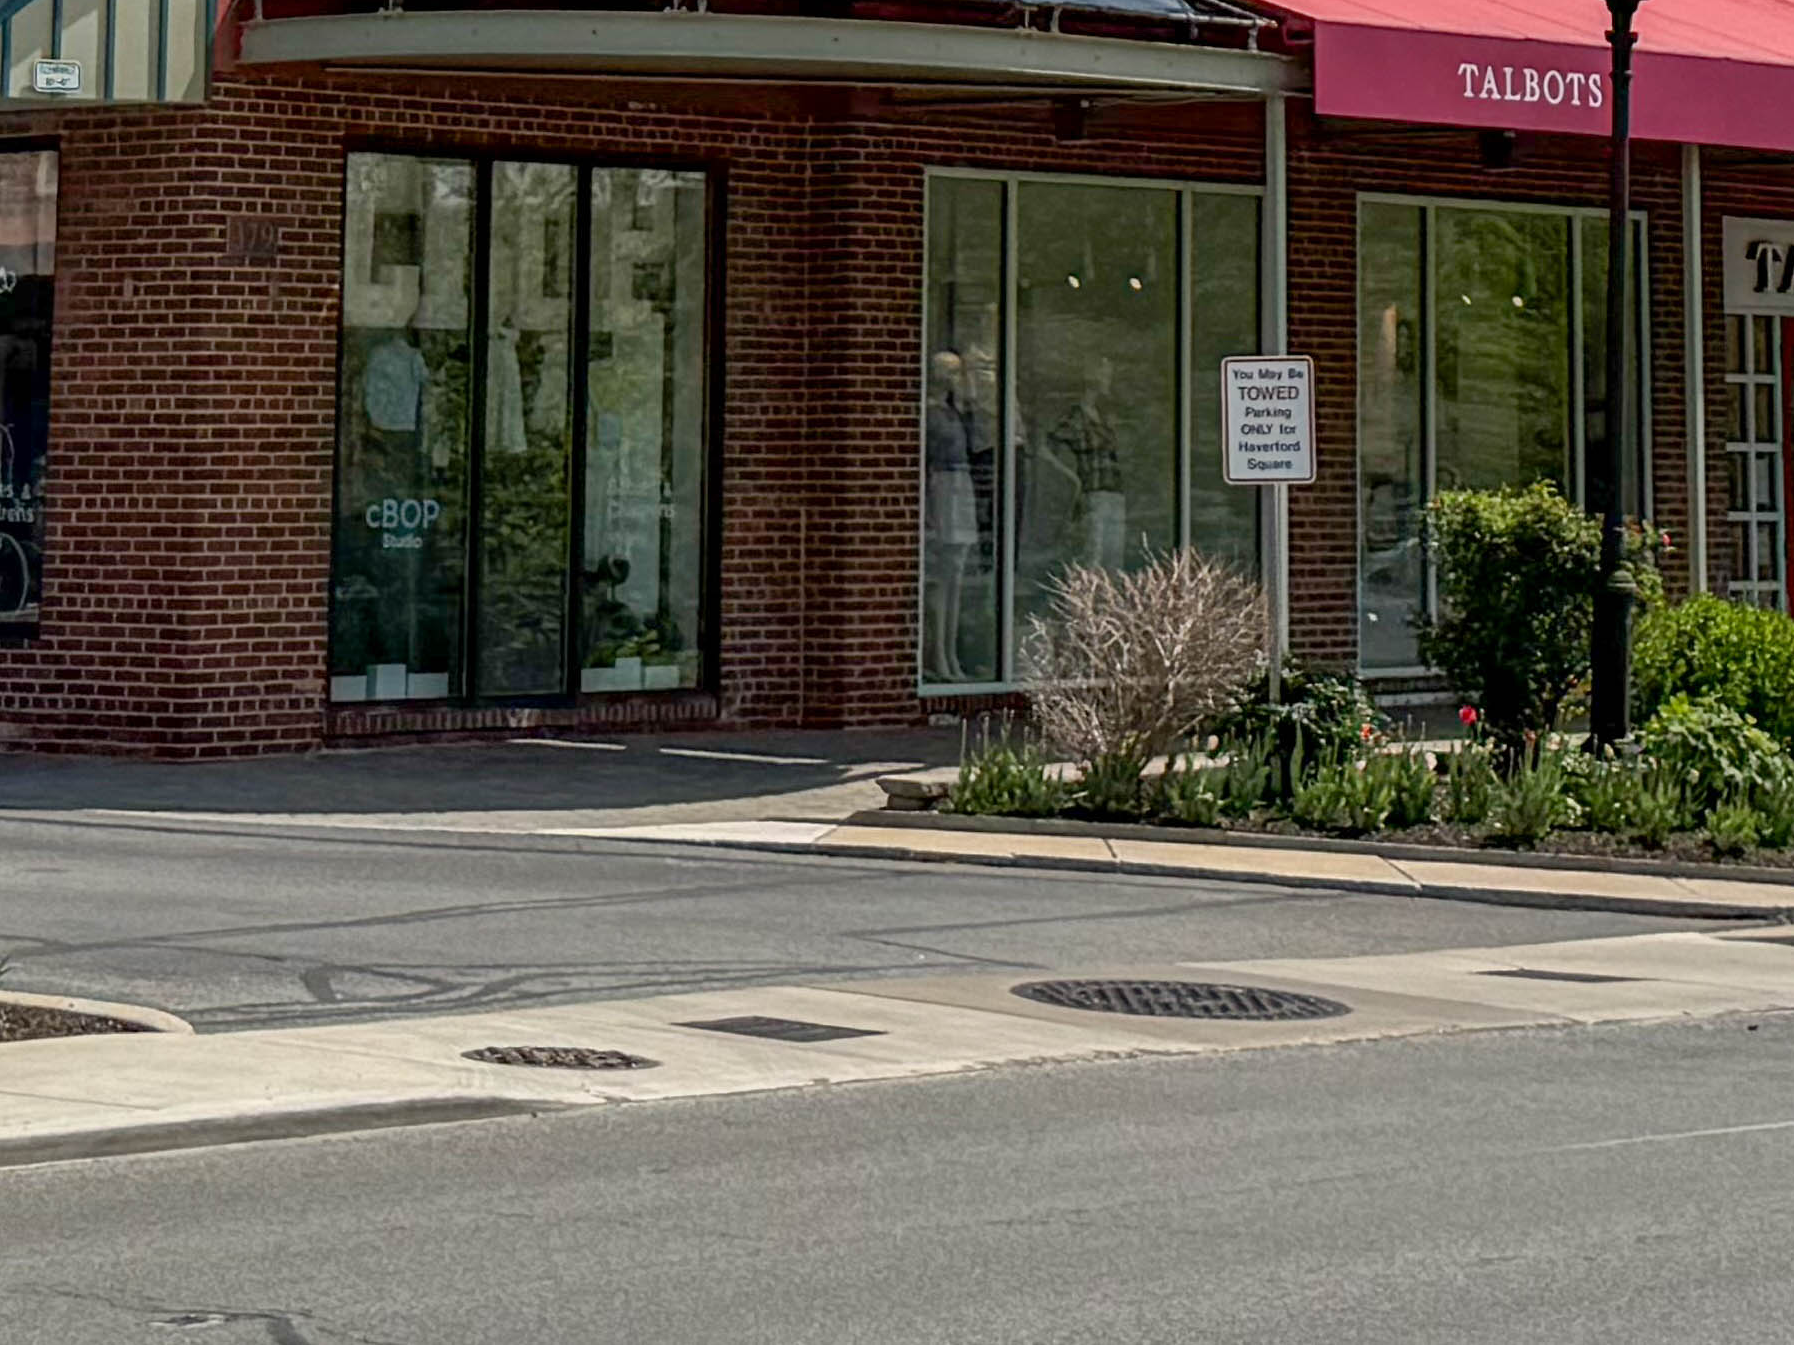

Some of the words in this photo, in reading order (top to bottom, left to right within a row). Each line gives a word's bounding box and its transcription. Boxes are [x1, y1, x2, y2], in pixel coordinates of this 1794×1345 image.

[1458, 63, 1603, 108] TALBOTS
[1233, 369, 1253, 380] You
[1259, 368, 1282, 381] May
[1288, 368, 1304, 379] Be
[1238, 385, 1300, 401] TOWED
[1245, 407, 1292, 419] Parking
[1241, 424, 1273, 435] ONLY
[1239, 441, 1301, 452] Haverford
[1247, 459, 1293, 471] Square
[366, 498, 441, 529] cBOP
